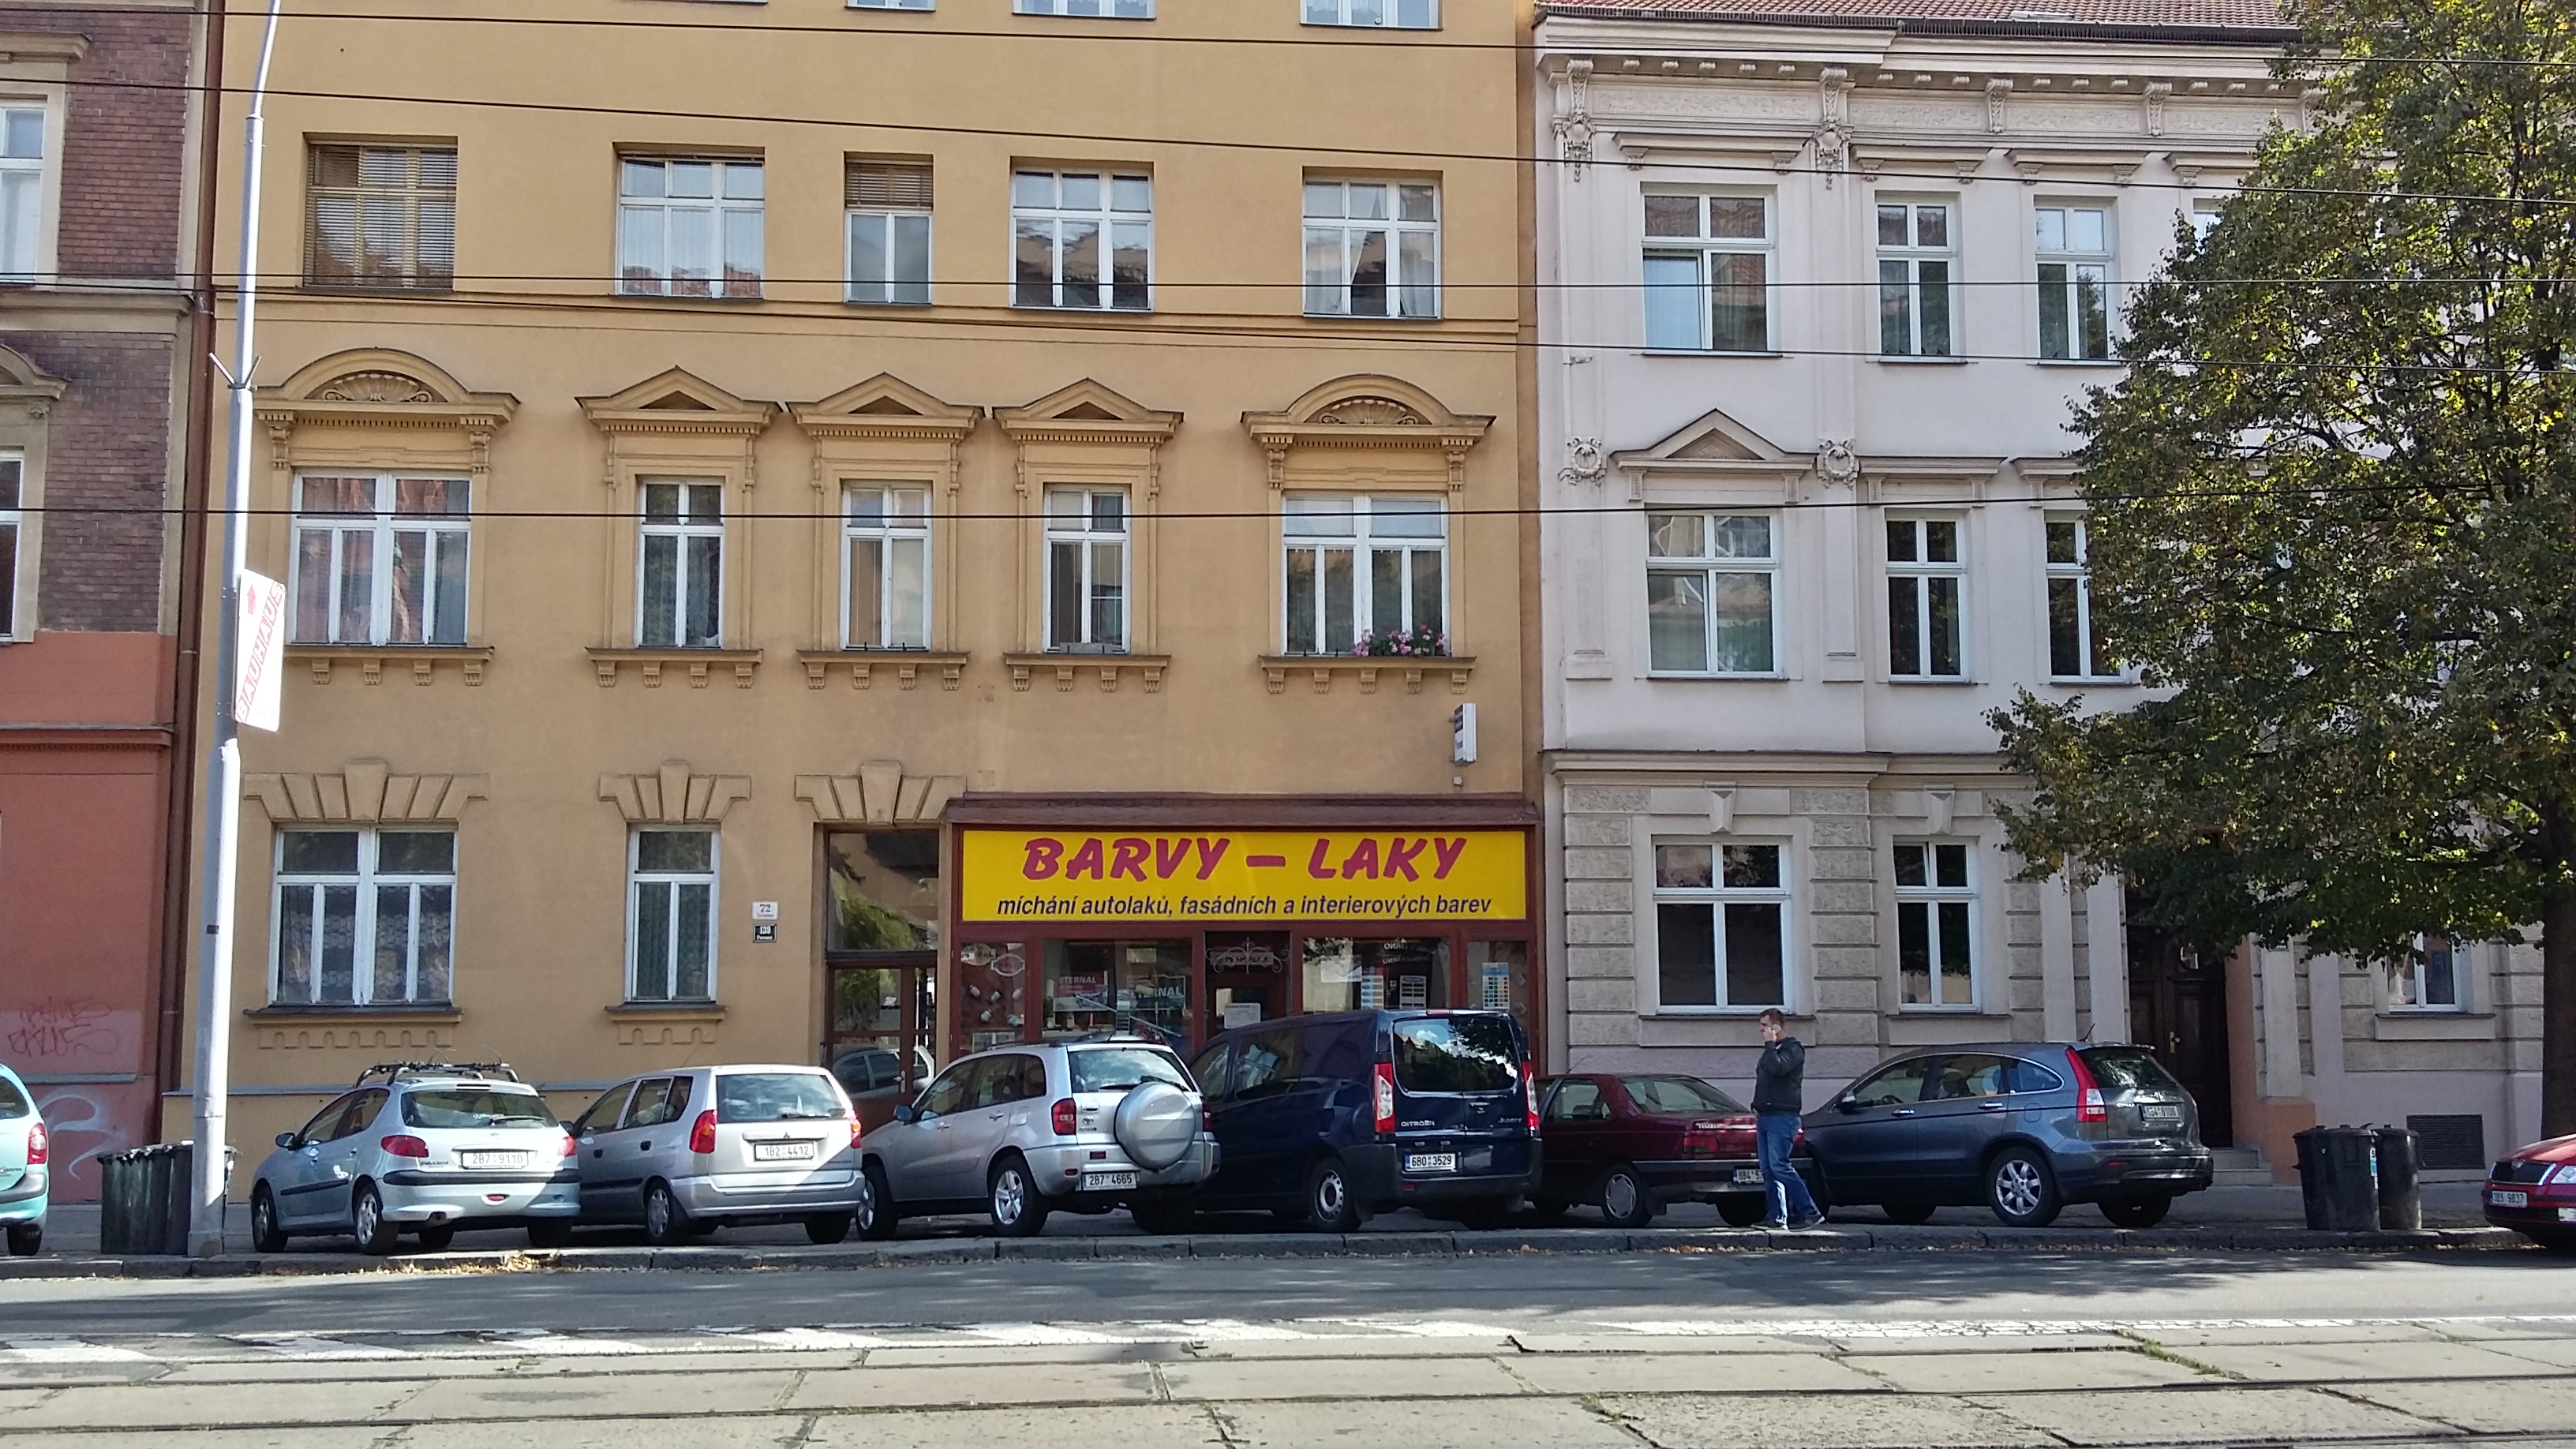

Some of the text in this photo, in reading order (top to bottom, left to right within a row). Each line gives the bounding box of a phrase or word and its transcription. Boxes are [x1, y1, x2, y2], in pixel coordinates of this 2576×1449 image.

[236, 581, 286, 722] BAUHAUS
[1023, 837, 1230, 882] BARVY
[1308, 837, 1466, 882] LAKY
[759, 904, 771, 913] 72
[997, 894, 1492, 918] míchání autolaků, fasádních a interierových barev
[764, 1145, 809, 1157] 1B2 4412
[473, 1154, 522, 1164] 2B7 9110
[1411, 1155, 1452, 1166] 6B0 3529
[1089, 1174, 1133, 1185] 2B7 4665
